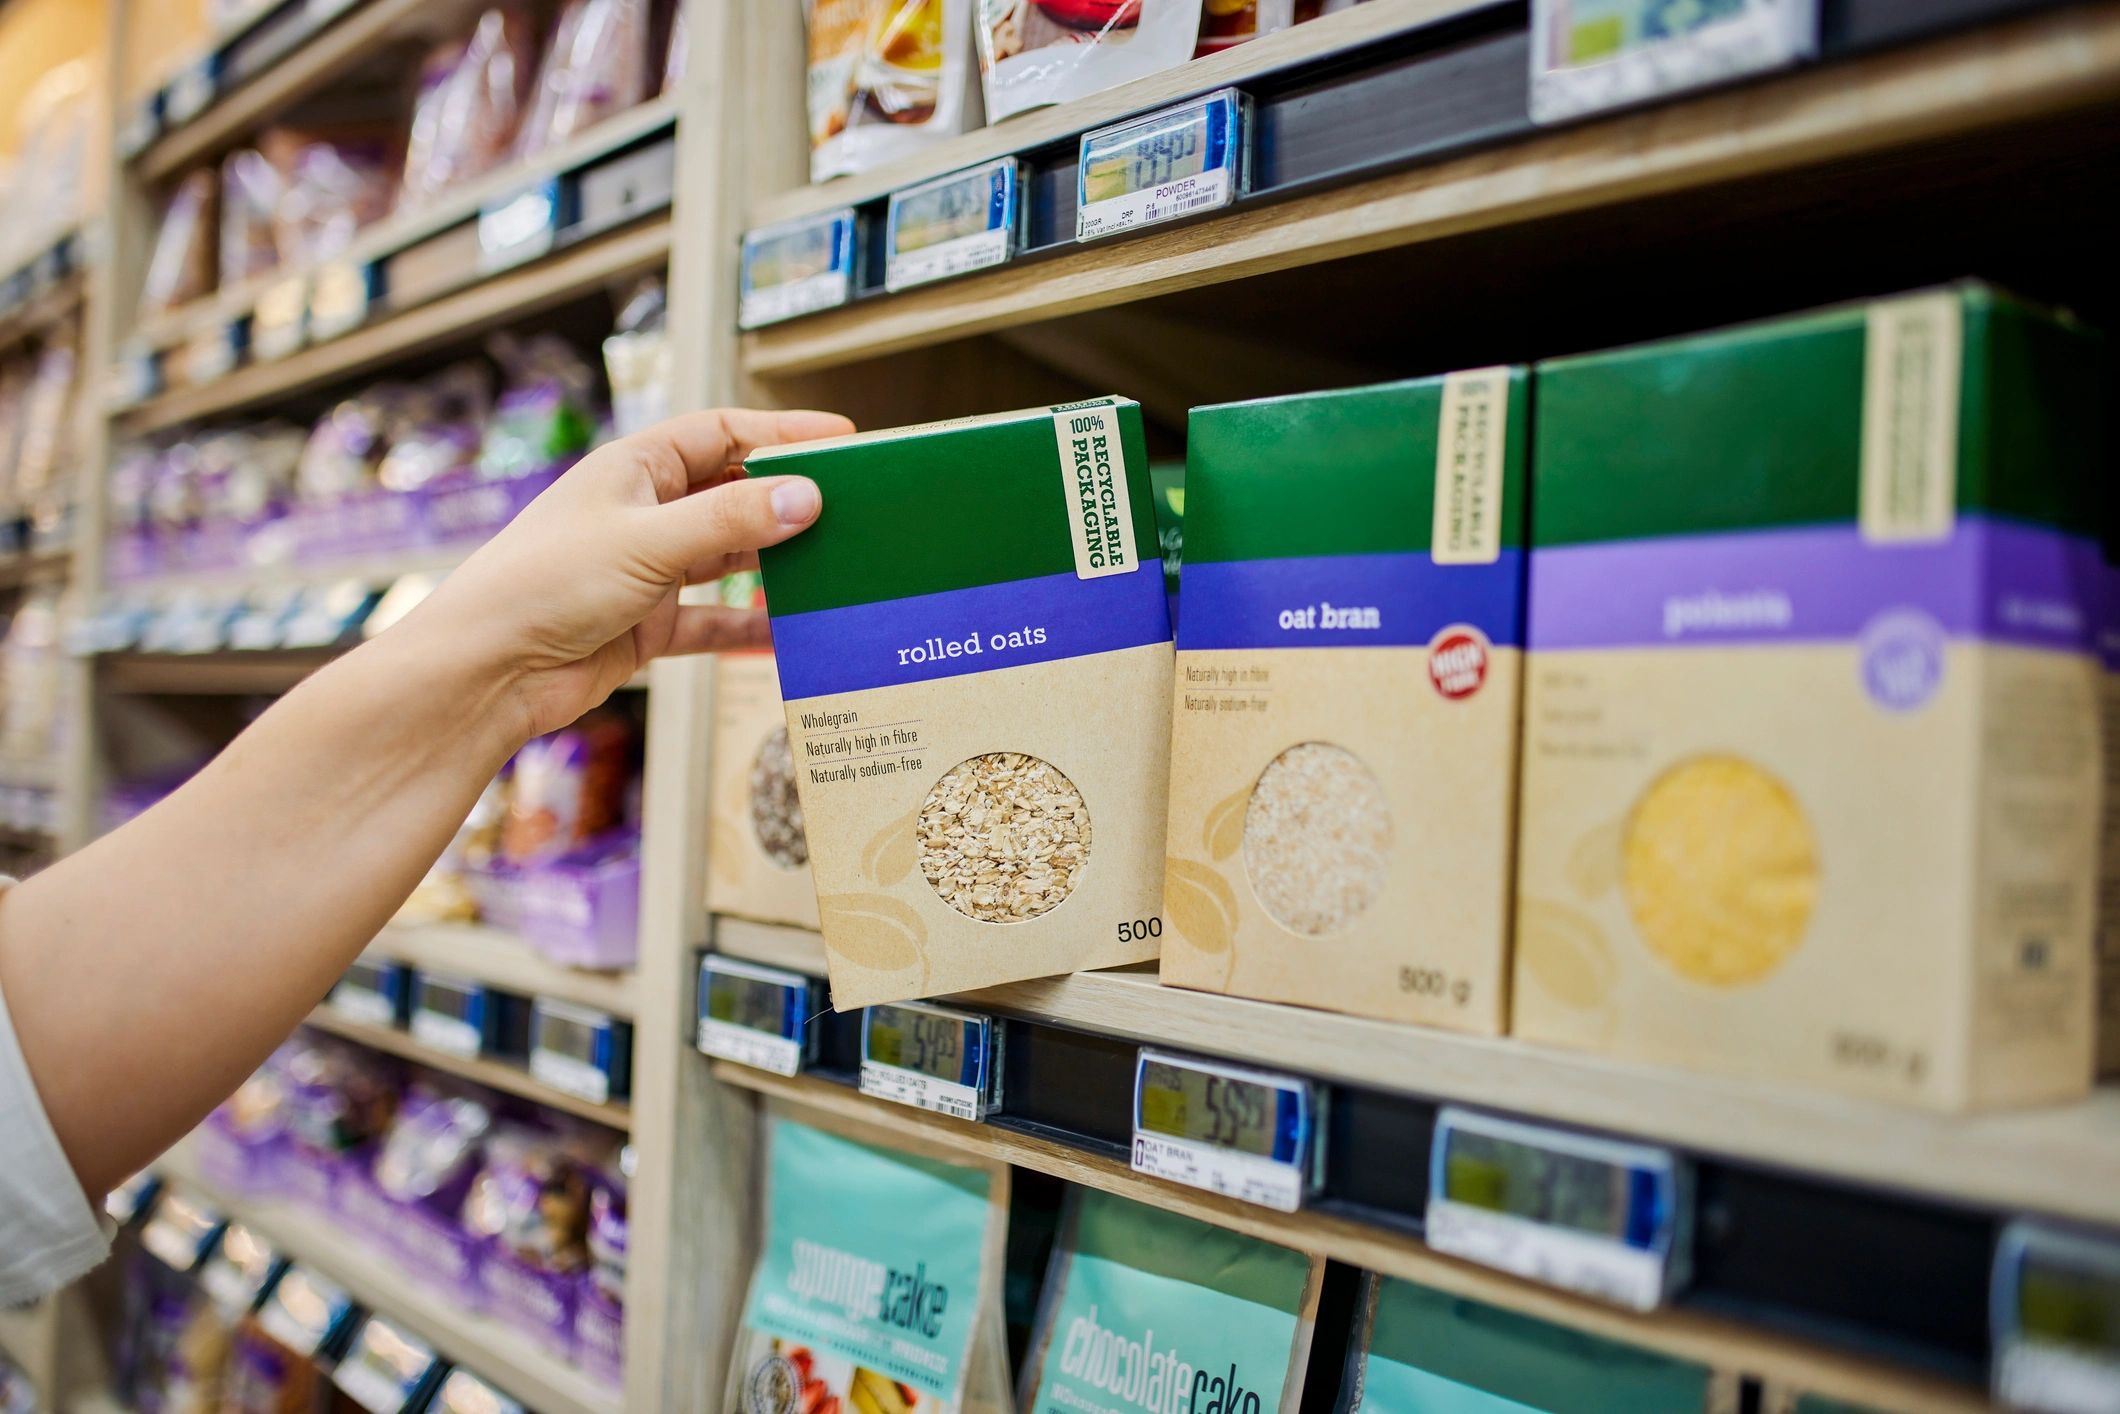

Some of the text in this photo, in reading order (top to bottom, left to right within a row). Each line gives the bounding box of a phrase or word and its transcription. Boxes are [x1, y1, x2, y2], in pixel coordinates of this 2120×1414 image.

[1156, 179, 1196, 199] POWDER
[1121, 210, 1133, 219] DRP
[1069, 414, 1104, 434] 100%
[1072, 437, 1105, 569] PACKAGING
[1092, 435, 1124, 566] RECYCLABLE
[1278, 601, 1382, 630] oat bran
[897, 625, 1047, 665] rolled oats
[1186, 665, 1219, 686] Naturally
[1185, 695, 1218, 715] Naturally
[800, 709, 858, 730] Wholegrain
[805, 729, 918, 757] Naturally high in fibre
[810, 756, 923, 784] Naturally sodium-free
[1117, 917, 1162, 943] 500
[1145, 1140, 1164, 1154] OAT
